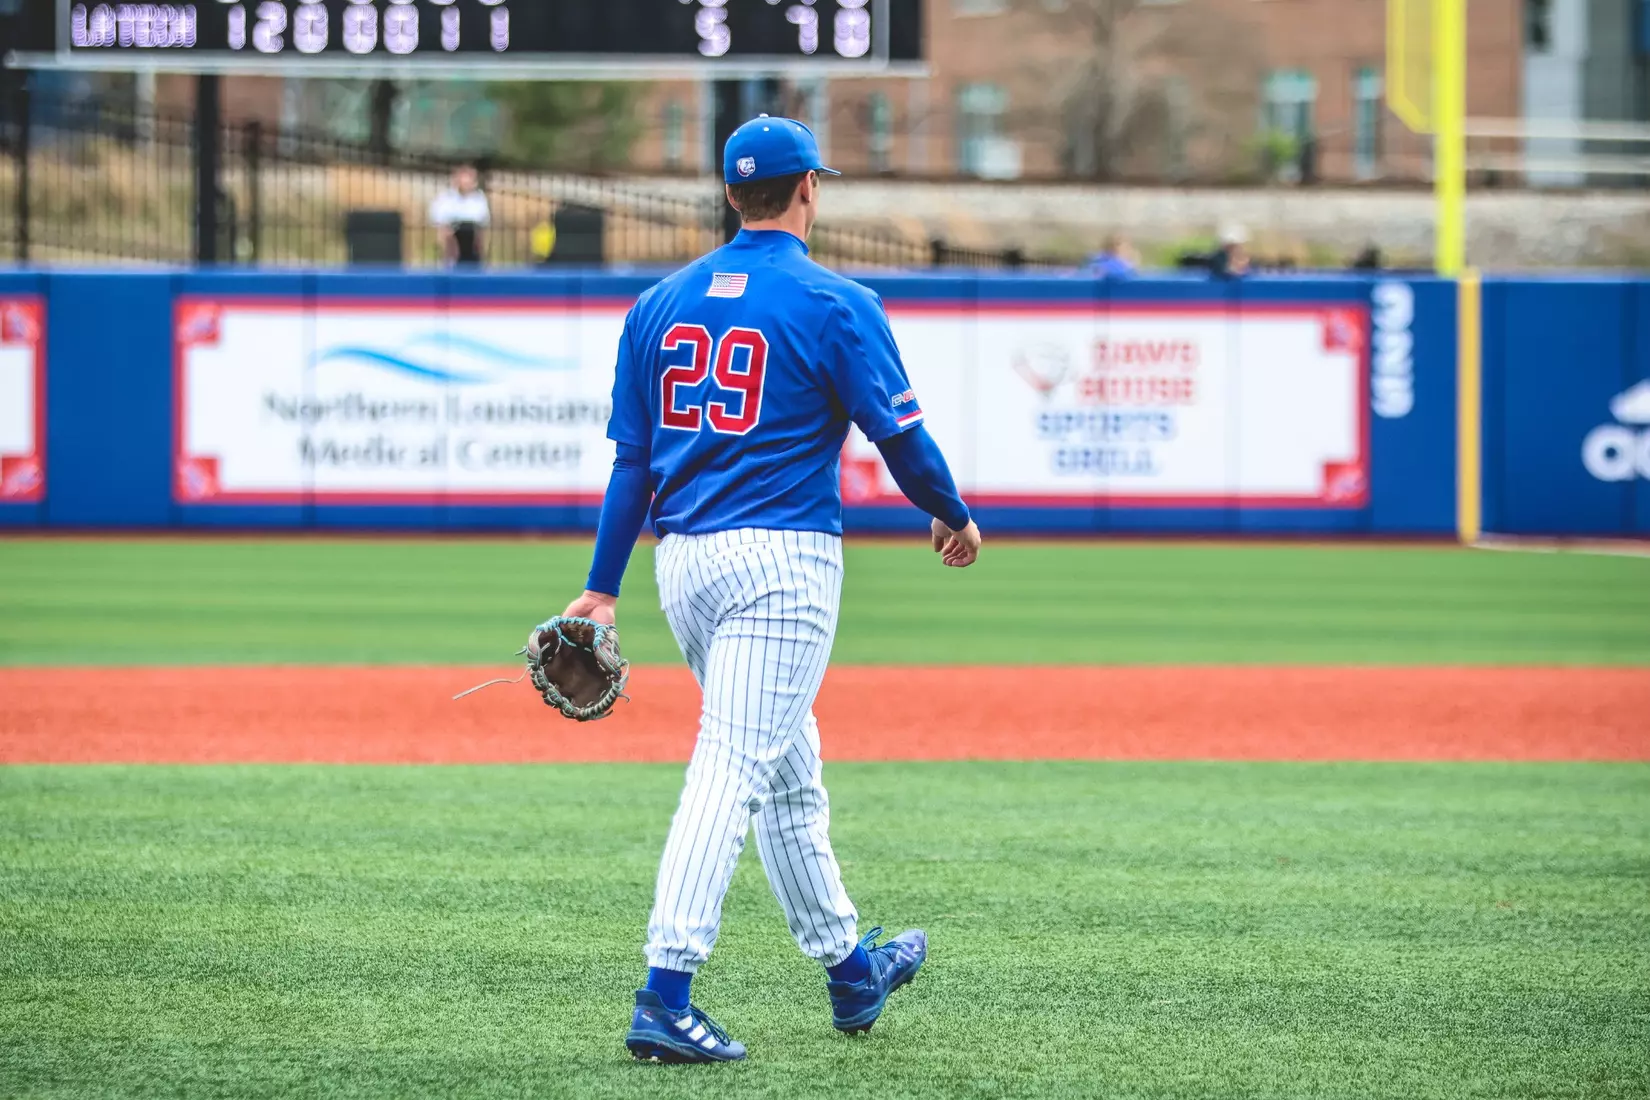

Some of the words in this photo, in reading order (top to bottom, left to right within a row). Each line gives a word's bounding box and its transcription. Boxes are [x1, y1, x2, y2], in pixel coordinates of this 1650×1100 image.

[228, 4, 246, 50] 1
[661, 322, 769, 435] 29
[262, 391, 438, 424] Northern
[297, 434, 443, 469] Medical
[456, 436, 583, 471] Center
